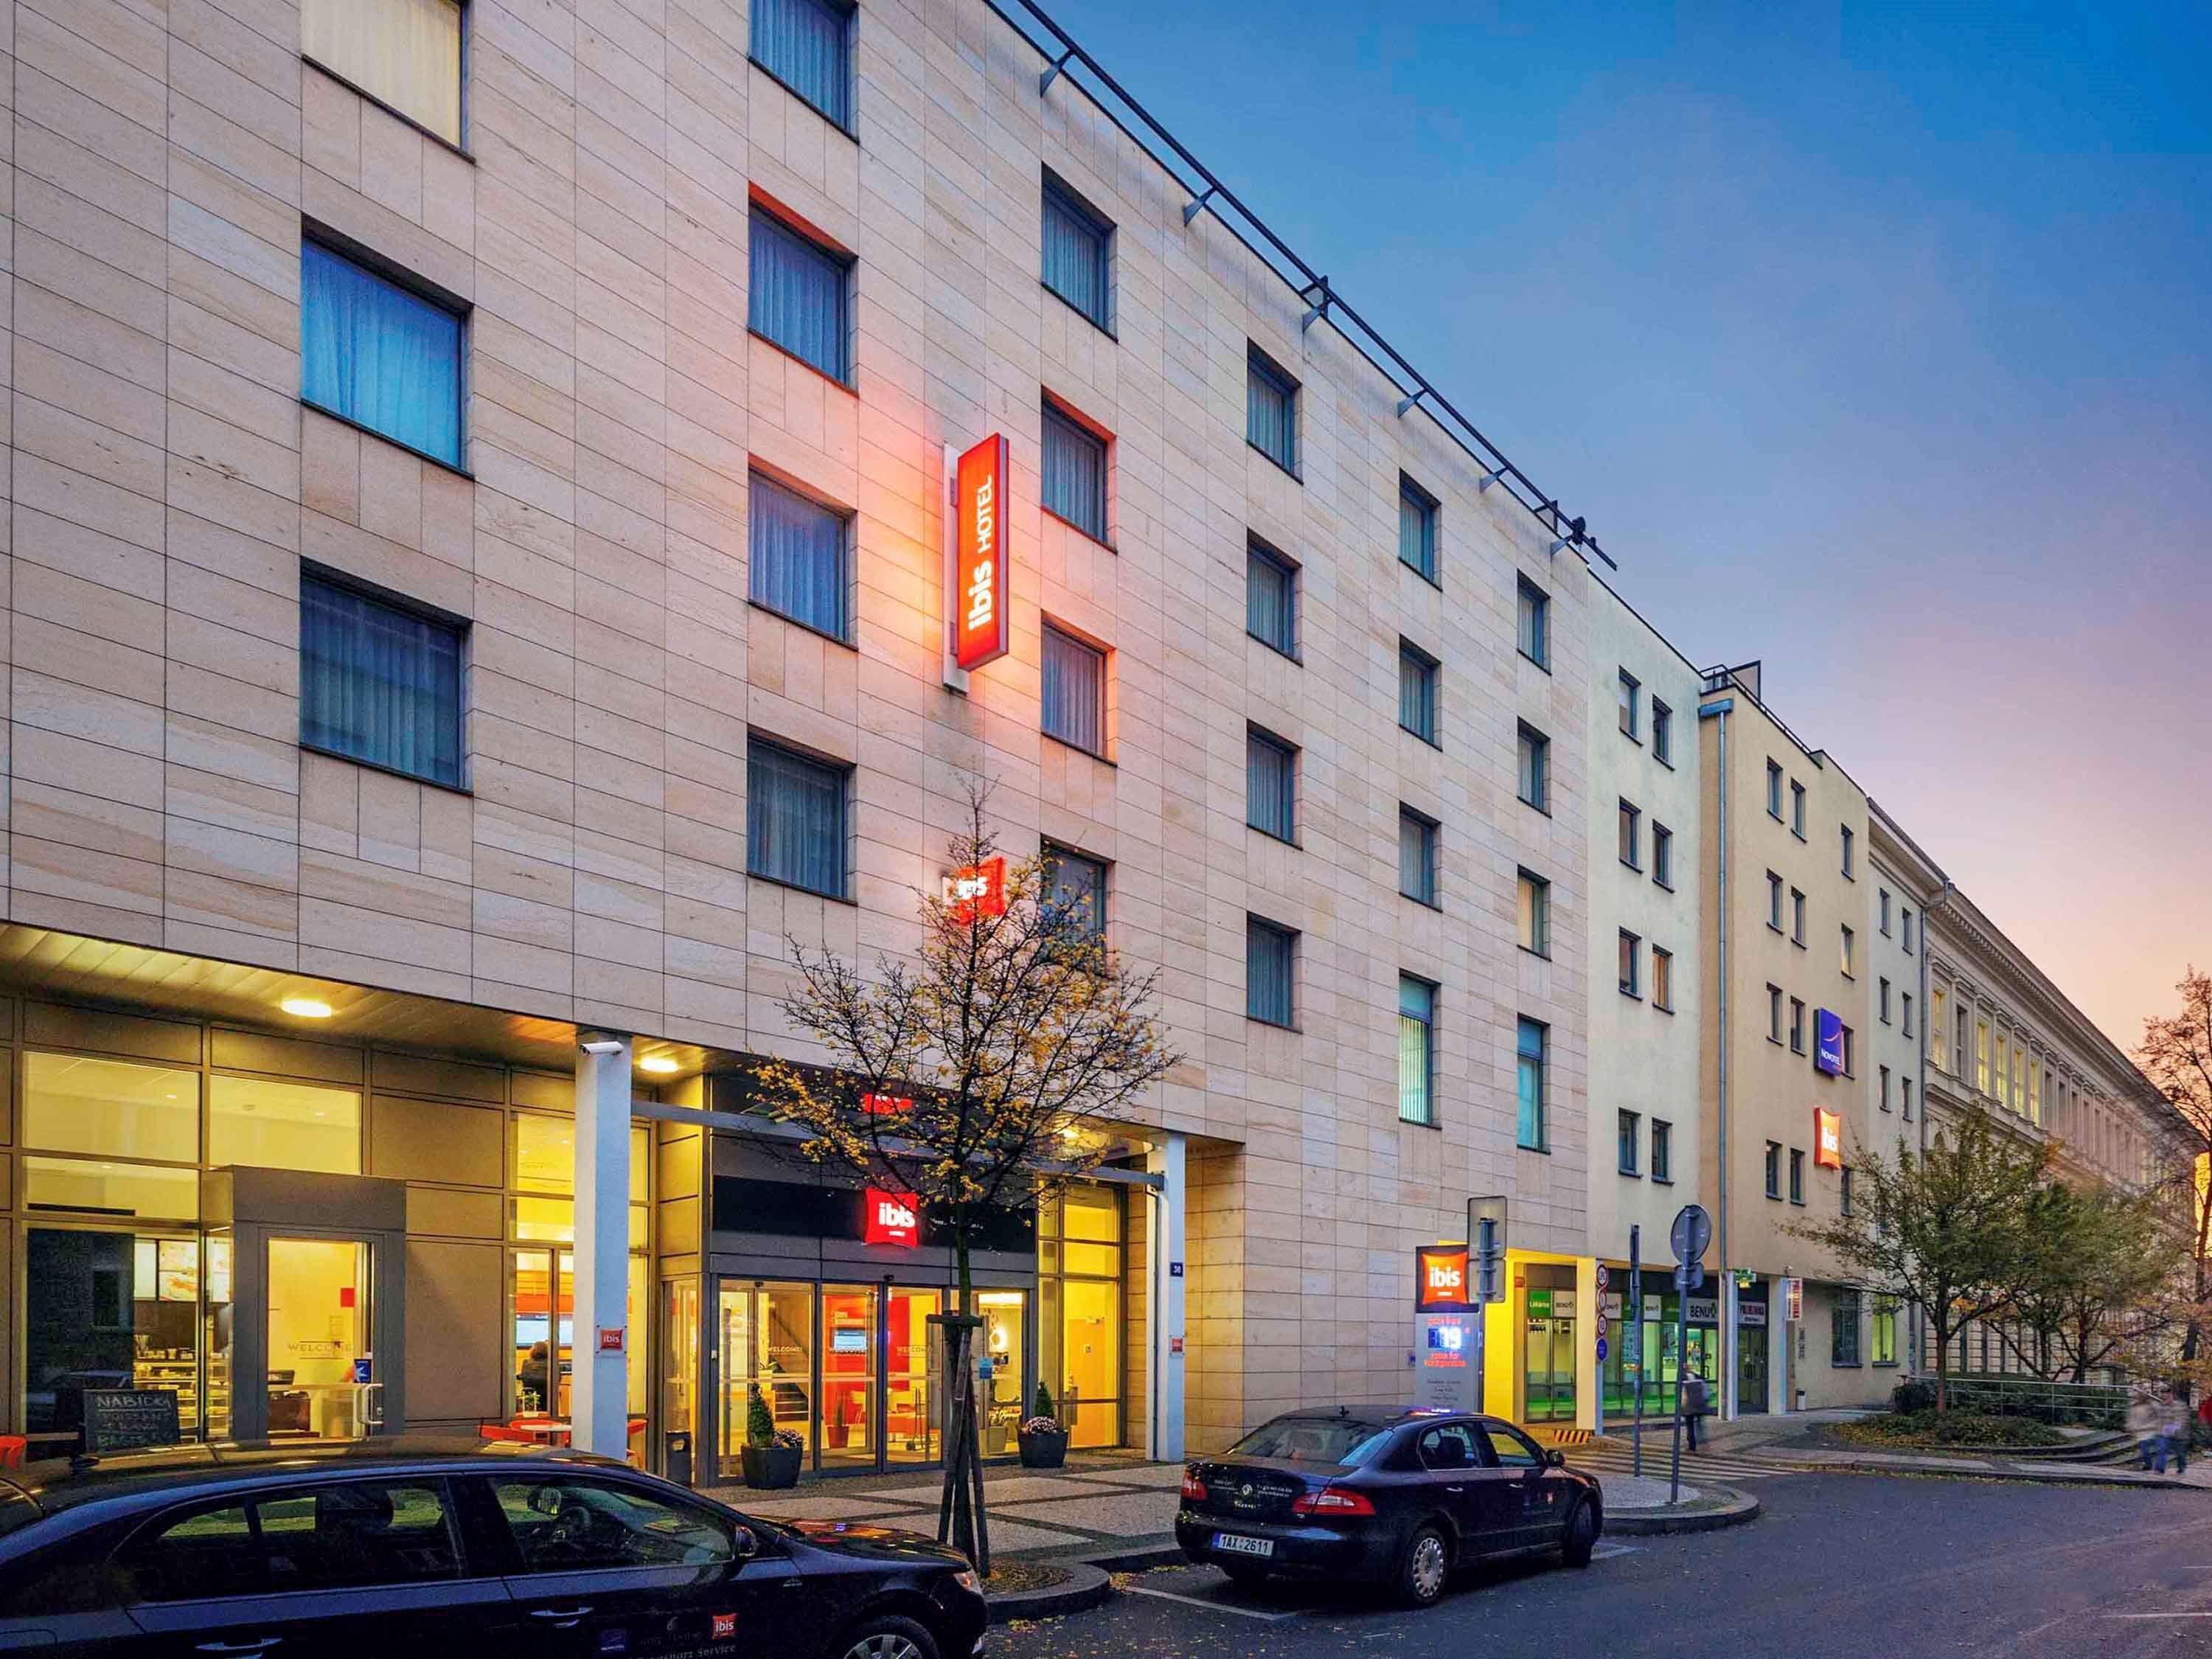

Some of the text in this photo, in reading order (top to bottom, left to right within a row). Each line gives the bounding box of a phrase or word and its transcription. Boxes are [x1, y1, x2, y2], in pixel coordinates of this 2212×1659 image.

[967, 475, 992, 630] ibis HOTEL
[1820, 1048, 1841, 1066] NOVOTEL
[878, 1202, 916, 1228] ibis
[1429, 1265, 1461, 1287] ibis
[1690, 1305, 1710, 1318] BENU
[603, 1333, 619, 1343] ibis
[1220, 1536, 1270, 1554] 1AX 2611
[715, 1621, 734, 1632] ibis
